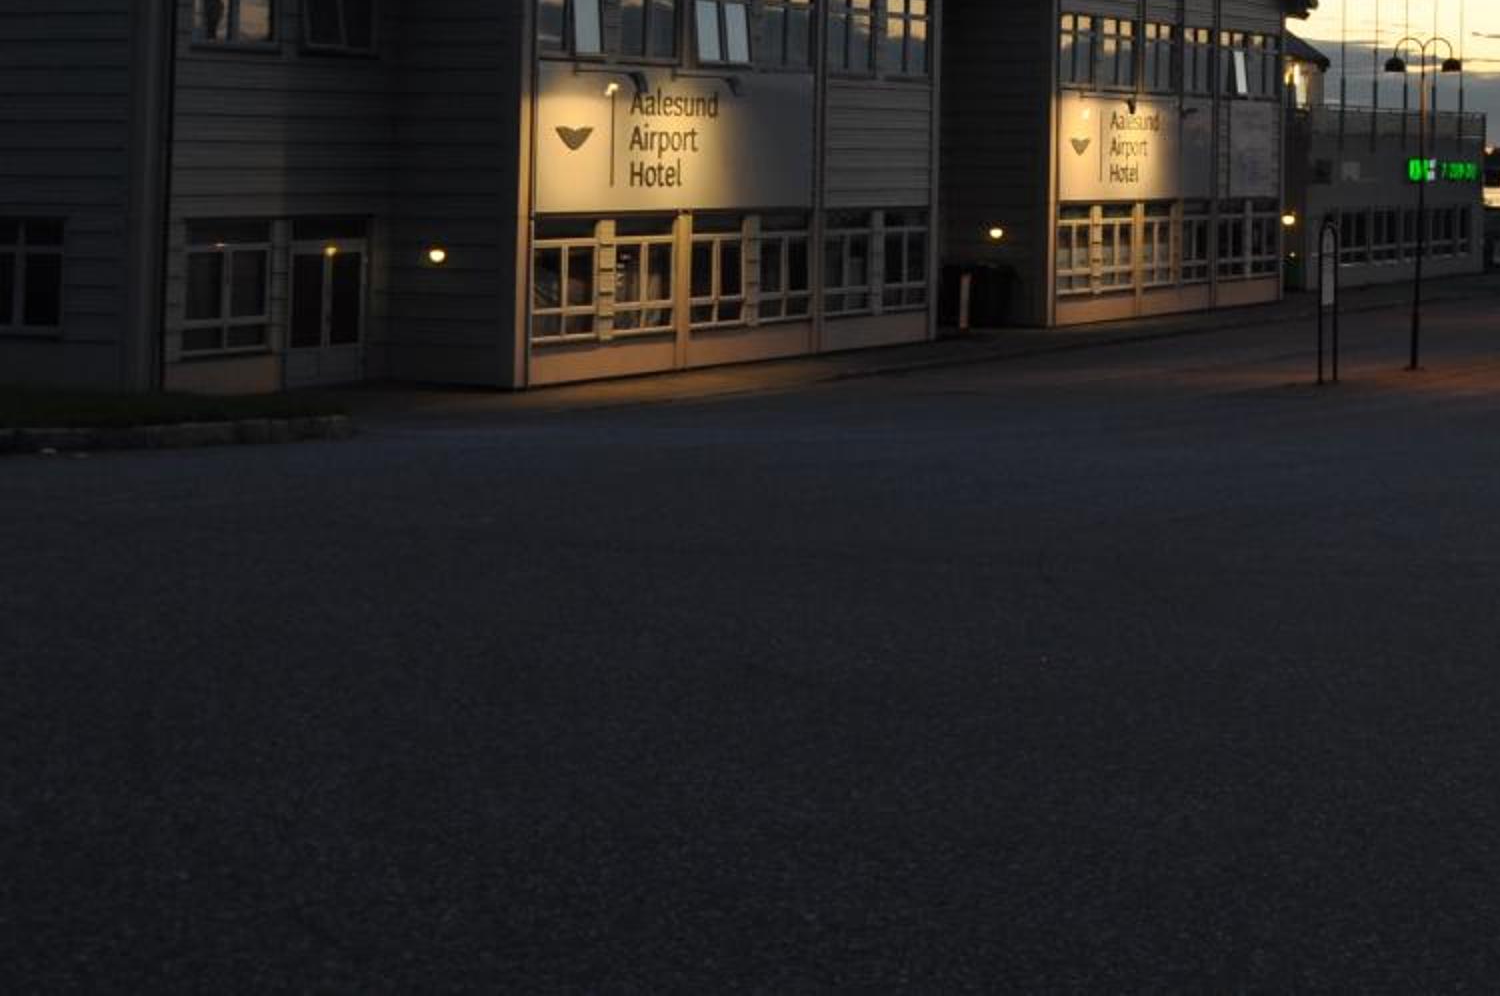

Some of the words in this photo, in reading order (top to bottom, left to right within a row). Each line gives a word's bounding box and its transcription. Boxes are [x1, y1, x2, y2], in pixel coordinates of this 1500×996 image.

[629, 87, 719, 119] Aalesund
[629, 123, 699, 159] Airport
[1109, 135, 1148, 160] Airport
[629, 157, 682, 187] Hotel
[1109, 161, 1139, 183] Hotel
